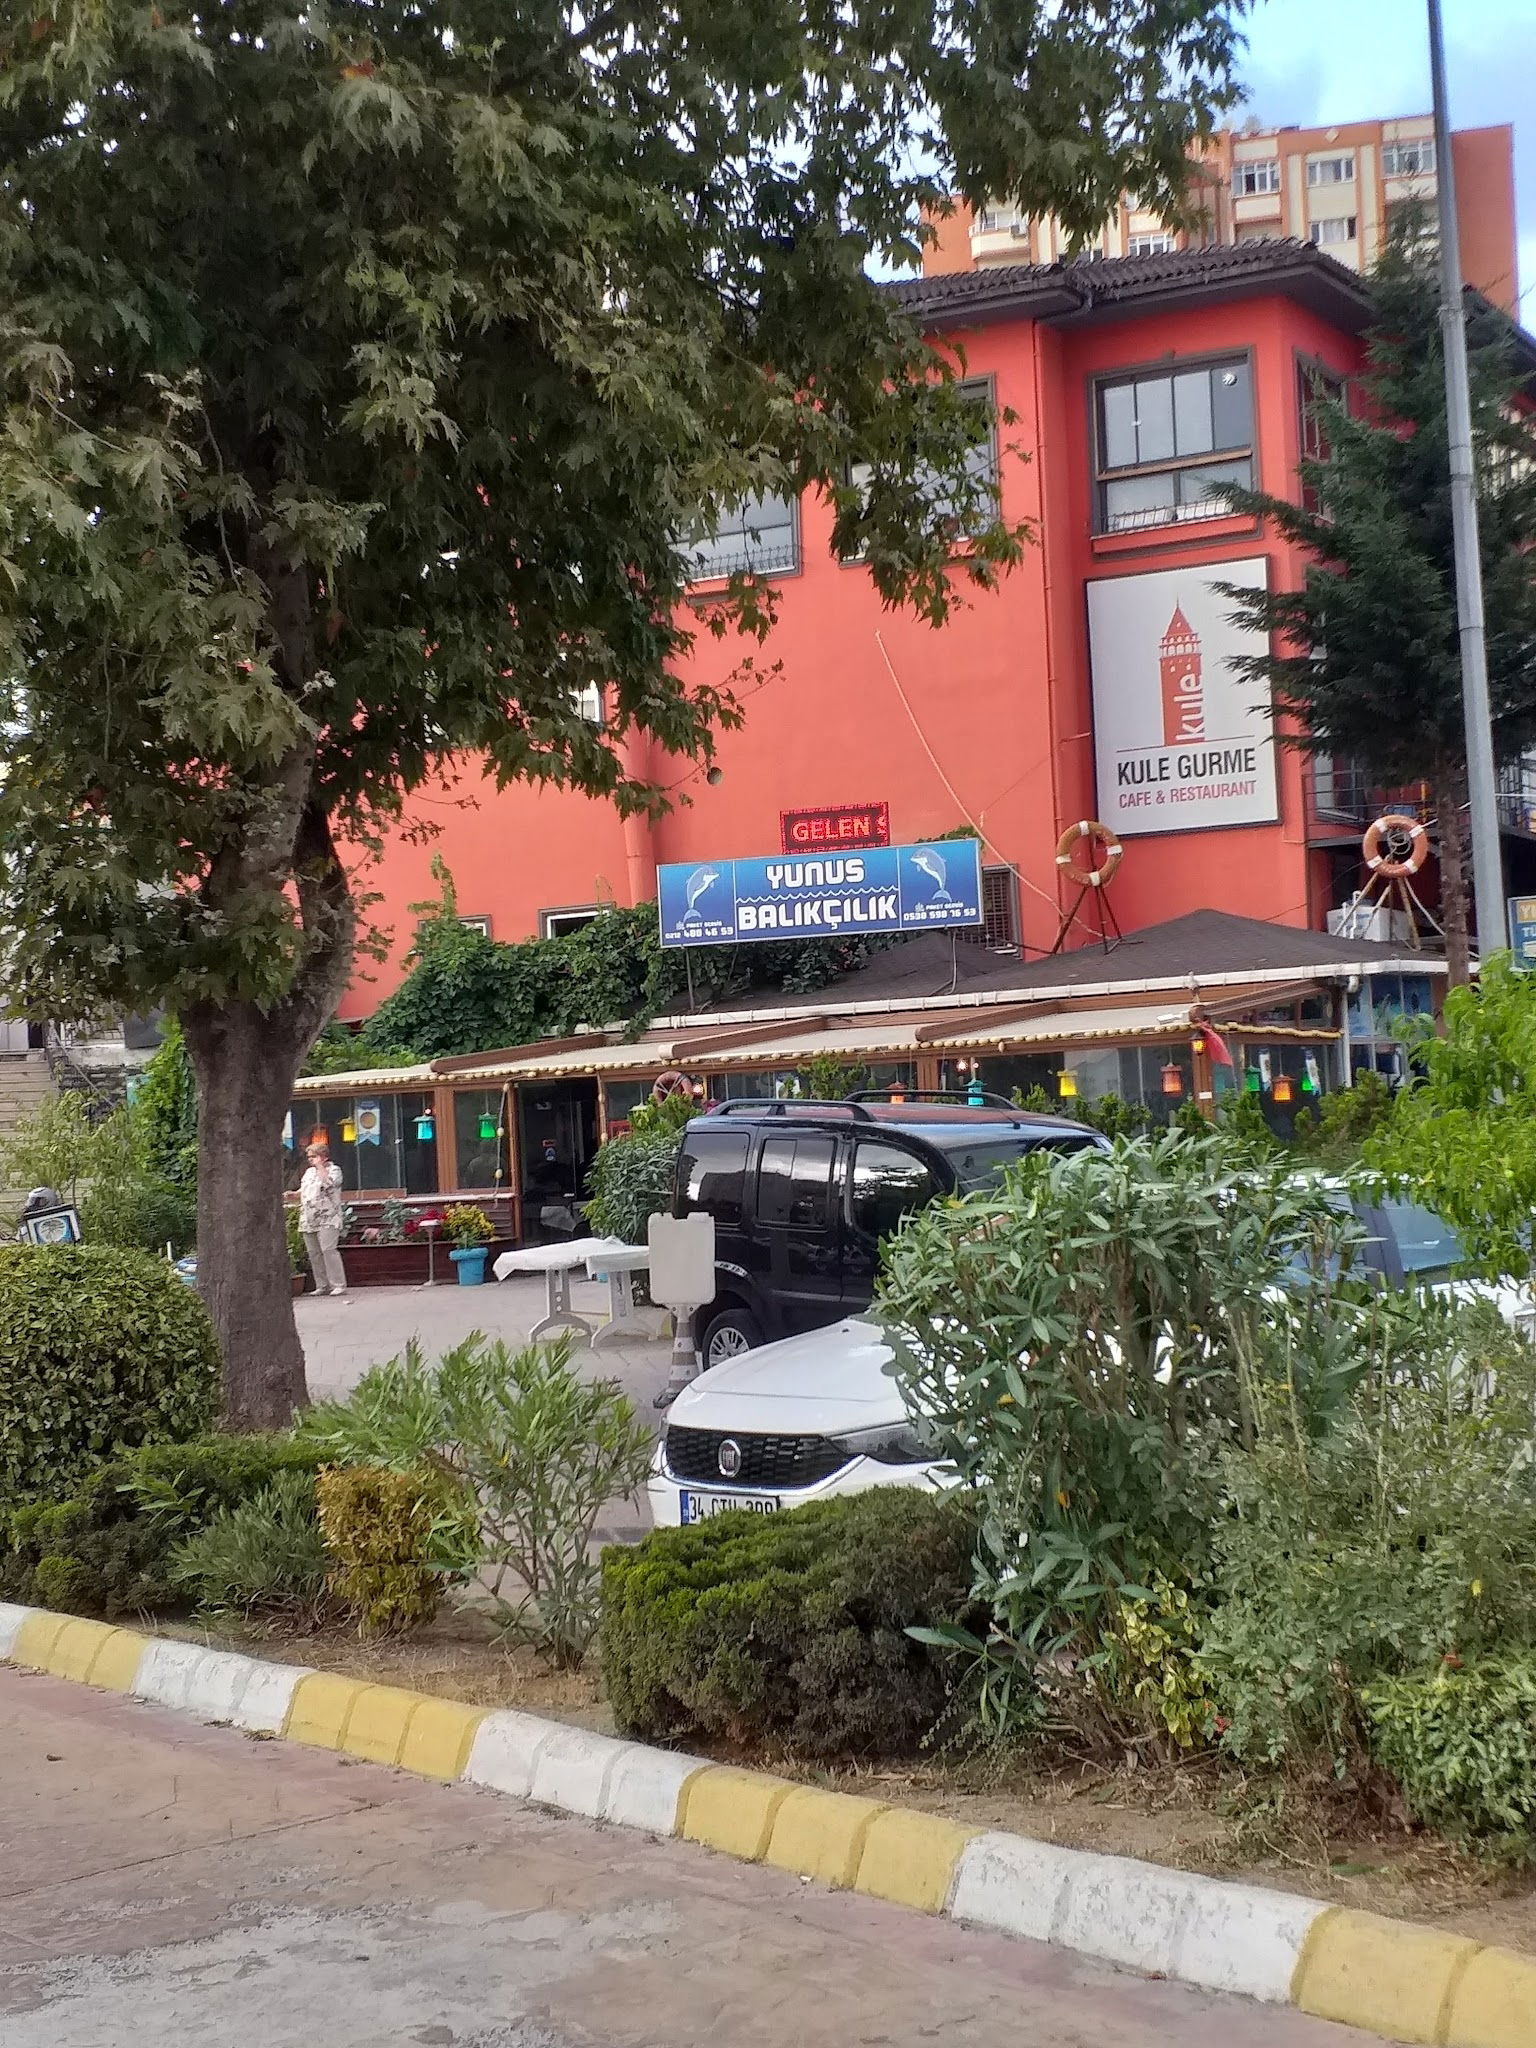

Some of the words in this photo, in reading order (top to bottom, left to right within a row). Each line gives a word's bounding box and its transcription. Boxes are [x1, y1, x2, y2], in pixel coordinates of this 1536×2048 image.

[1174, 673, 1205, 740] kule
[1117, 757, 1171, 787] KULE
[1178, 748, 1257, 779] GURME
[1120, 791, 1152, 809] CAFE
[1156, 789, 1166, 804] &
[1170, 780, 1257, 803] RESTAURANT
[792, 816, 870, 842] GELEN
[766, 858, 865, 889] YUNUS
[738, 895, 897, 930] BALIKÇILIK
[690, 1496, 704, 1520] 34
